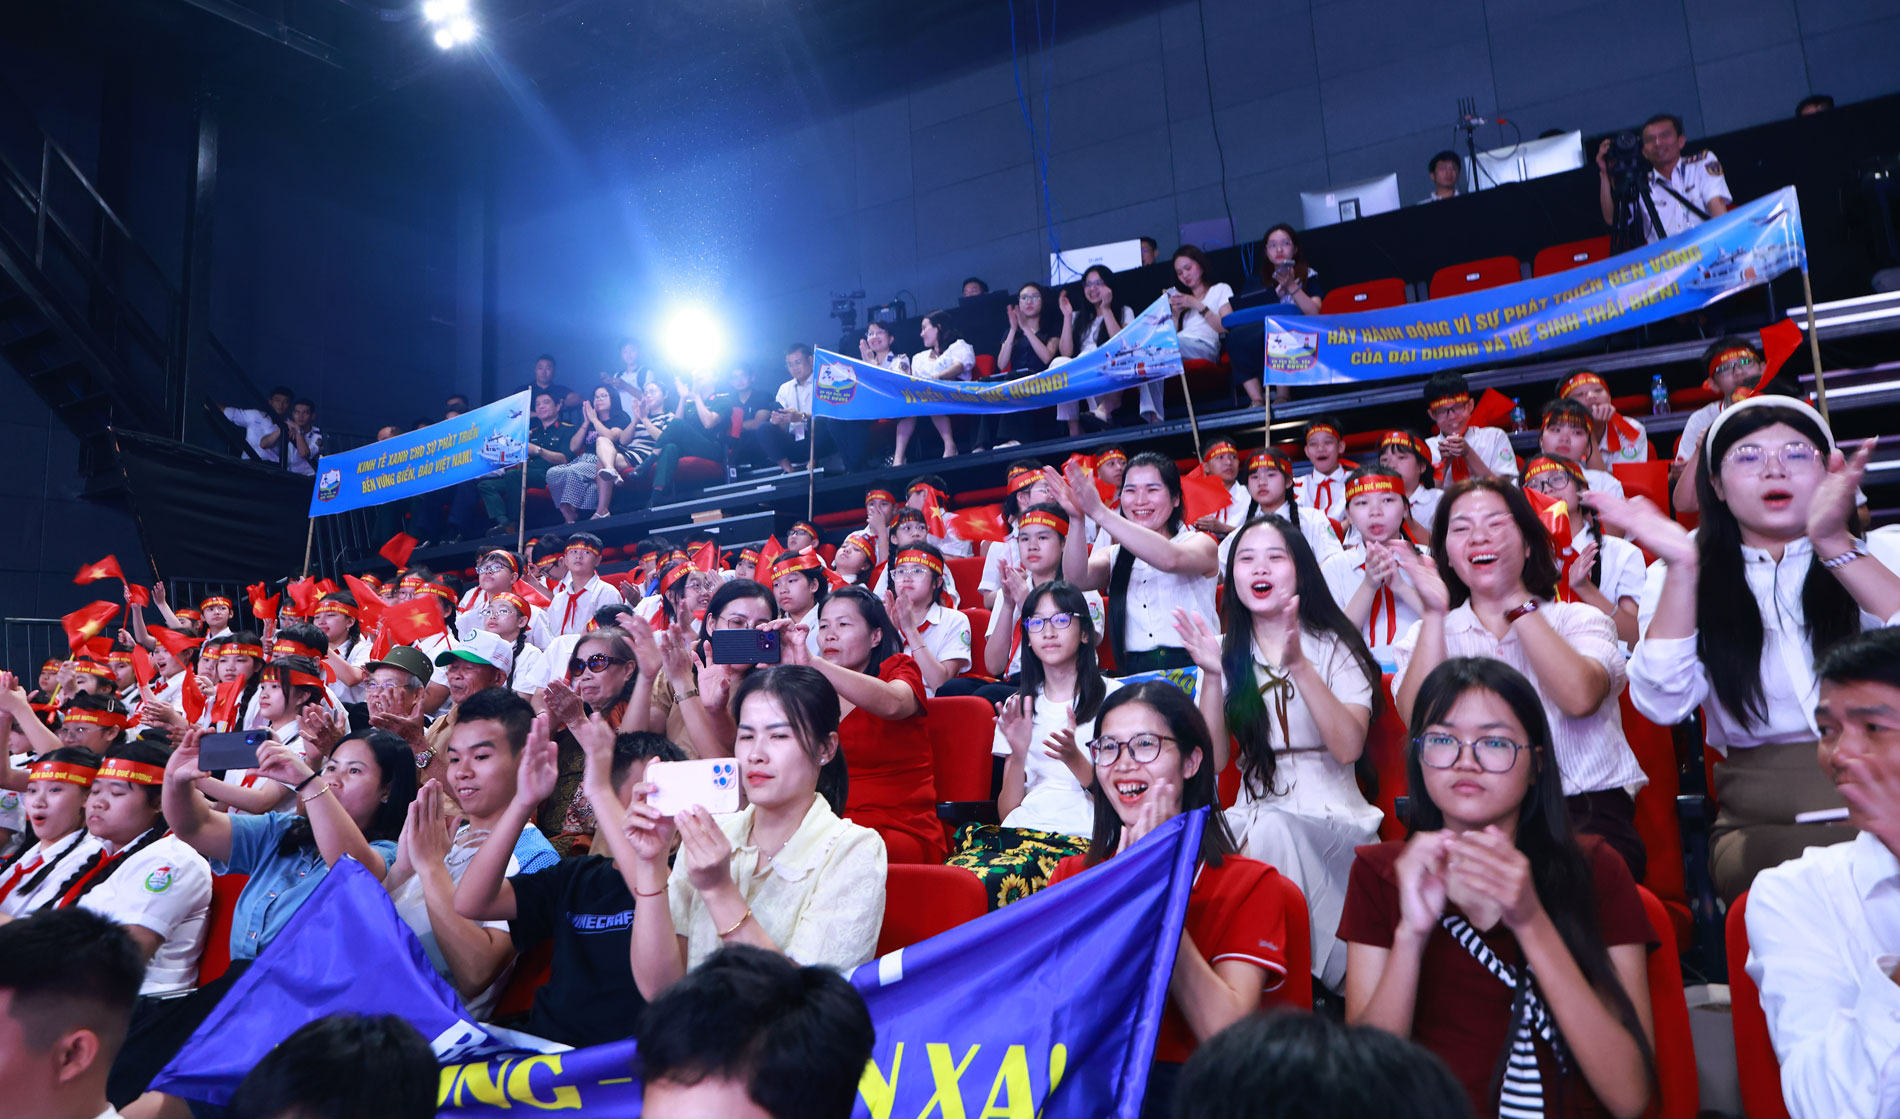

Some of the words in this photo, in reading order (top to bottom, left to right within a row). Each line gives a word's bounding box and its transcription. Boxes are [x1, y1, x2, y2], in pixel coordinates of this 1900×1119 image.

[1327, 326, 1356, 345] HÃY
[1362, 324, 1405, 343] HÀNH
[1405, 320, 1451, 341] ĐỘNG
[1453, 312, 1471, 336] VÌ
[1475, 308, 1501, 330] SỰ
[1503, 296, 1549, 324] PHÁT
[1351, 346, 1384, 365] CỦA
[1388, 350, 1416, 365] ĐẠI
[1420, 341, 1479, 362] DƯƠNG
[1482, 333, 1506, 355] VÀ
[1508, 324, 1533, 349] HỆ
[1535, 313, 1581, 341] SINH
[1582, 296, 1626, 327] THÁI
[1008, 371, 1068, 400] HƯƠNG!
[357, 458, 377, 474] KINH
[377, 450, 388, 469] TẾ
[387, 449, 409, 467] XANH
[409, 445, 425, 460] CHO
[426, 439, 438, 456] SỰ
[437, 432, 458, 452] PHÁT
[458, 422, 481, 445] TRIỂN
[362, 475, 377, 494] BỀN
[376, 472, 396, 490] VỮNG
[417, 459, 435, 478] ĐẢO
[434, 455, 452, 475] VIỆT
[452, 449, 473, 468] NAM!
